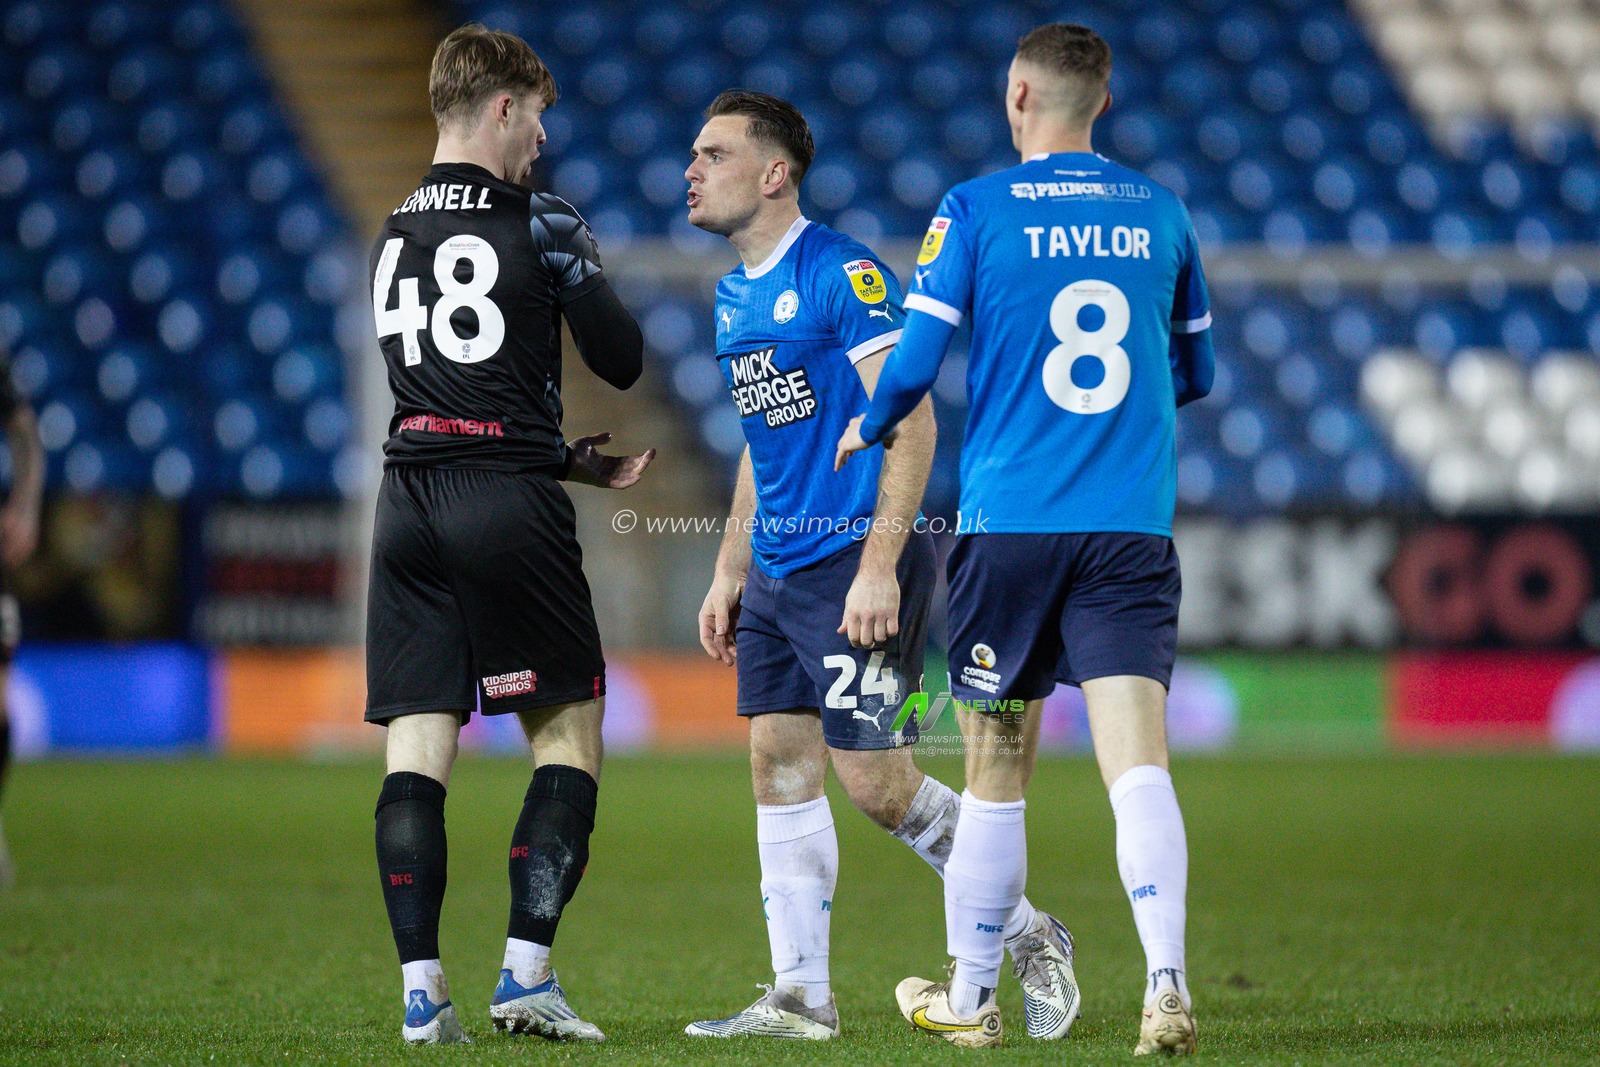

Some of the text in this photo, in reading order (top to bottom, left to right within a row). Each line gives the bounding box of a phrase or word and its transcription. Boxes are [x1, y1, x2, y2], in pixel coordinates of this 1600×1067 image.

[1024, 225, 1151, 259] TAYLOR
[373, 234, 505, 366] 48
[1042, 279, 1131, 414] 8
[732, 349, 780, 386] MICK
[732, 370, 812, 415] GEORGE
[399, 413, 504, 437] parliament
[766, 398, 816, 427] GROUP
[482, 669, 533, 687] KIDSUPER
[486, 680, 532, 697] STUDIOS
[823, 651, 899, 709] 24
[511, 846, 529, 859] BFC
[389, 873, 413, 886] BFC
[1132, 884, 1157, 902] PUFC
[976, 922, 1004, 933] PUFC
